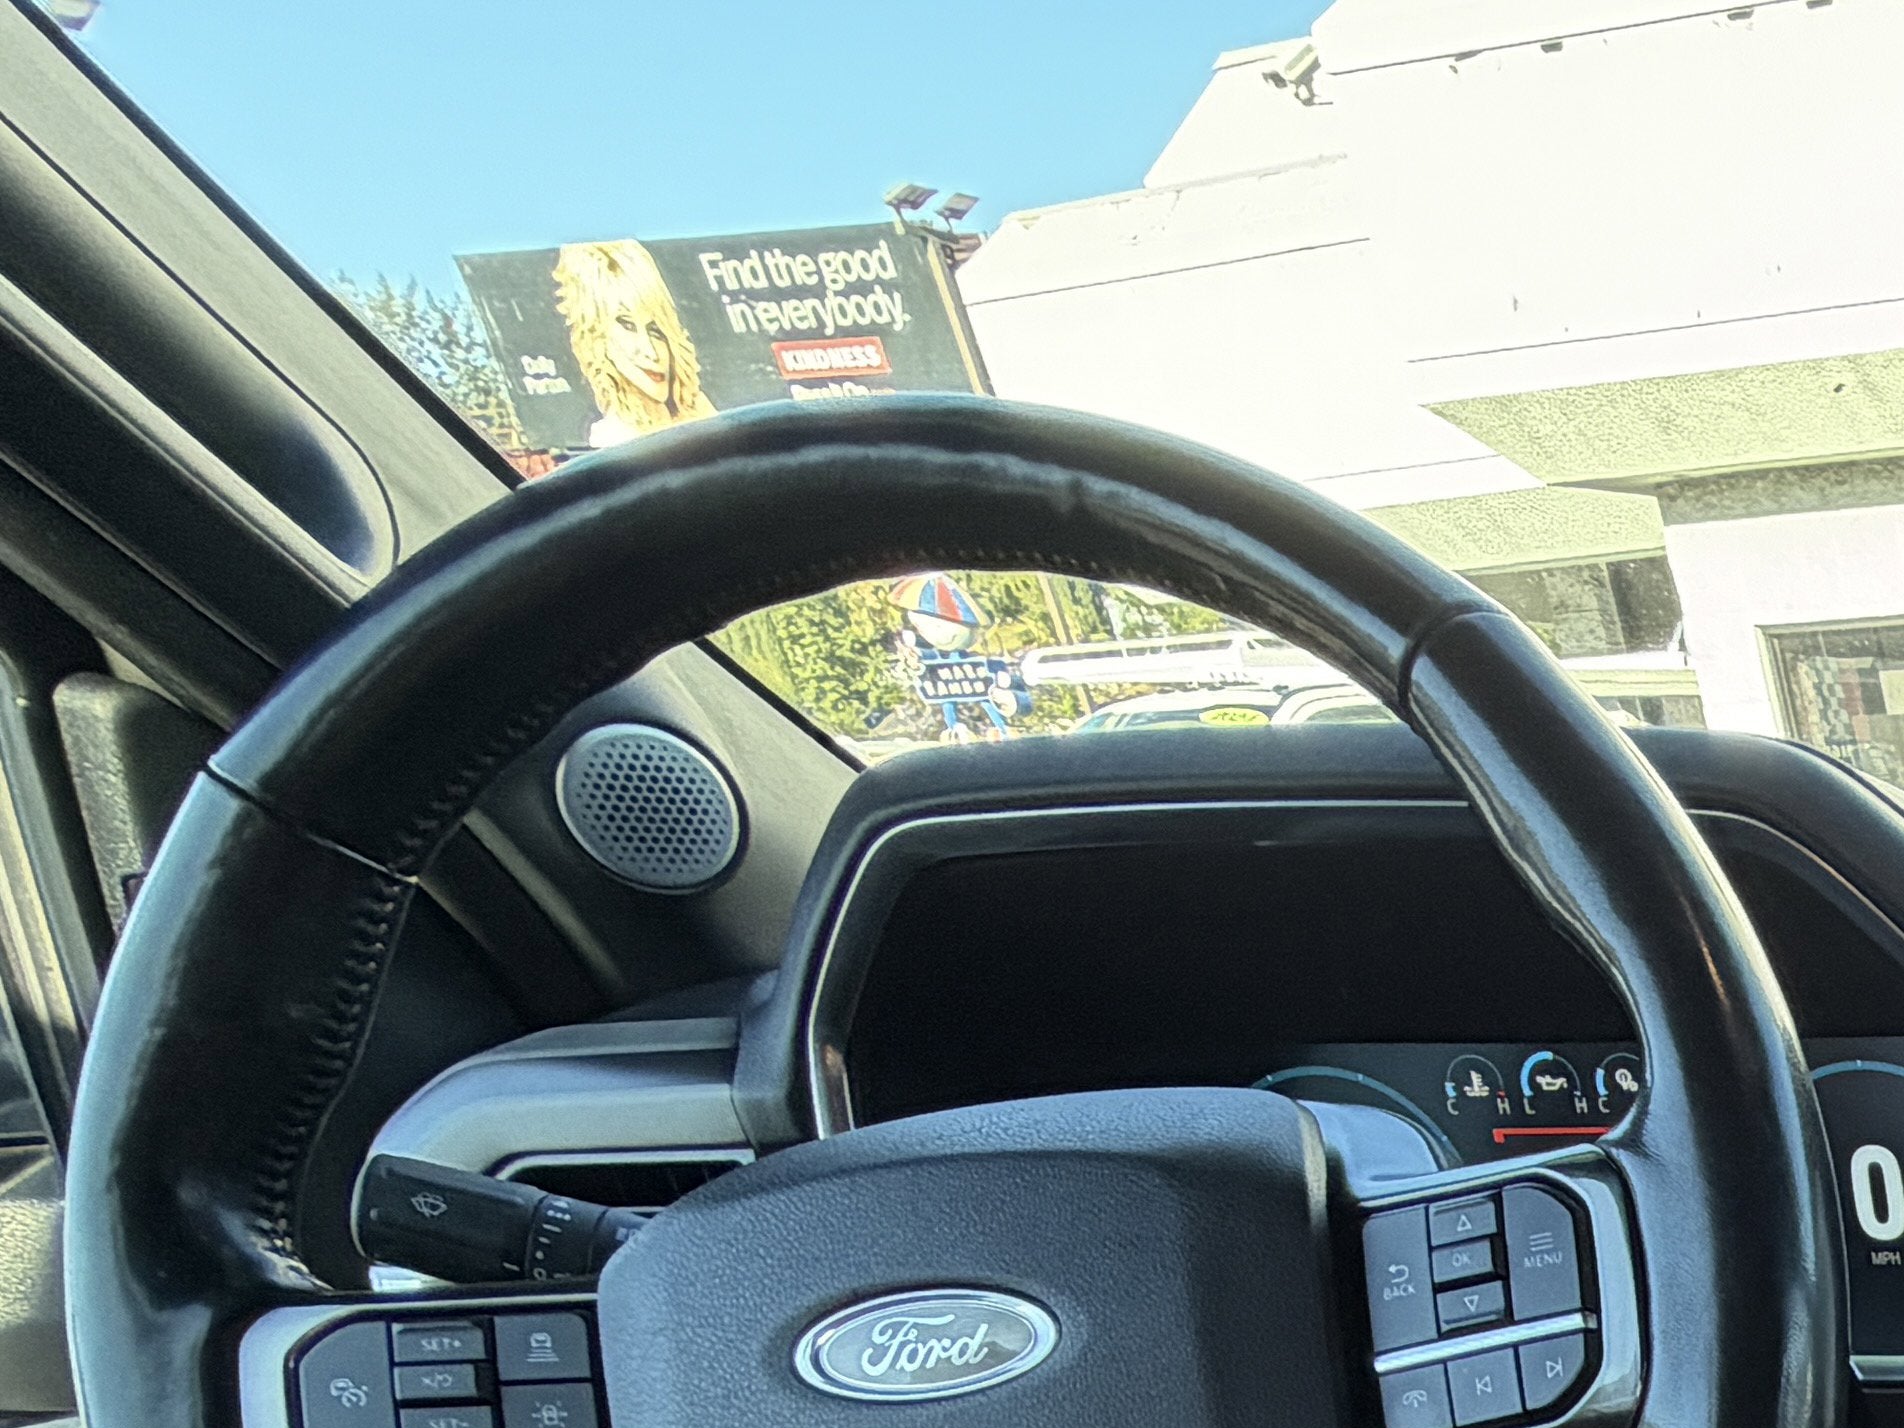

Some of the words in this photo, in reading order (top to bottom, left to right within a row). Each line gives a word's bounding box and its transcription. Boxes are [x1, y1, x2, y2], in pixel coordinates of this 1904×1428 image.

[698, 249, 769, 291] Find
[763, 248, 819, 287] the
[818, 239, 898, 291] good
[720, 294, 759, 333] in
[754, 284, 913, 336] everybody.
[780, 345, 881, 371] KINDNESS
[1451, 1252, 1472, 1269] OK
[1524, 1249, 1563, 1269] MENU
[1871, 1251, 1901, 1266] MPH
[1382, 1280, 1416, 1300] BACK
[860, 1313, 993, 1378] Ford
